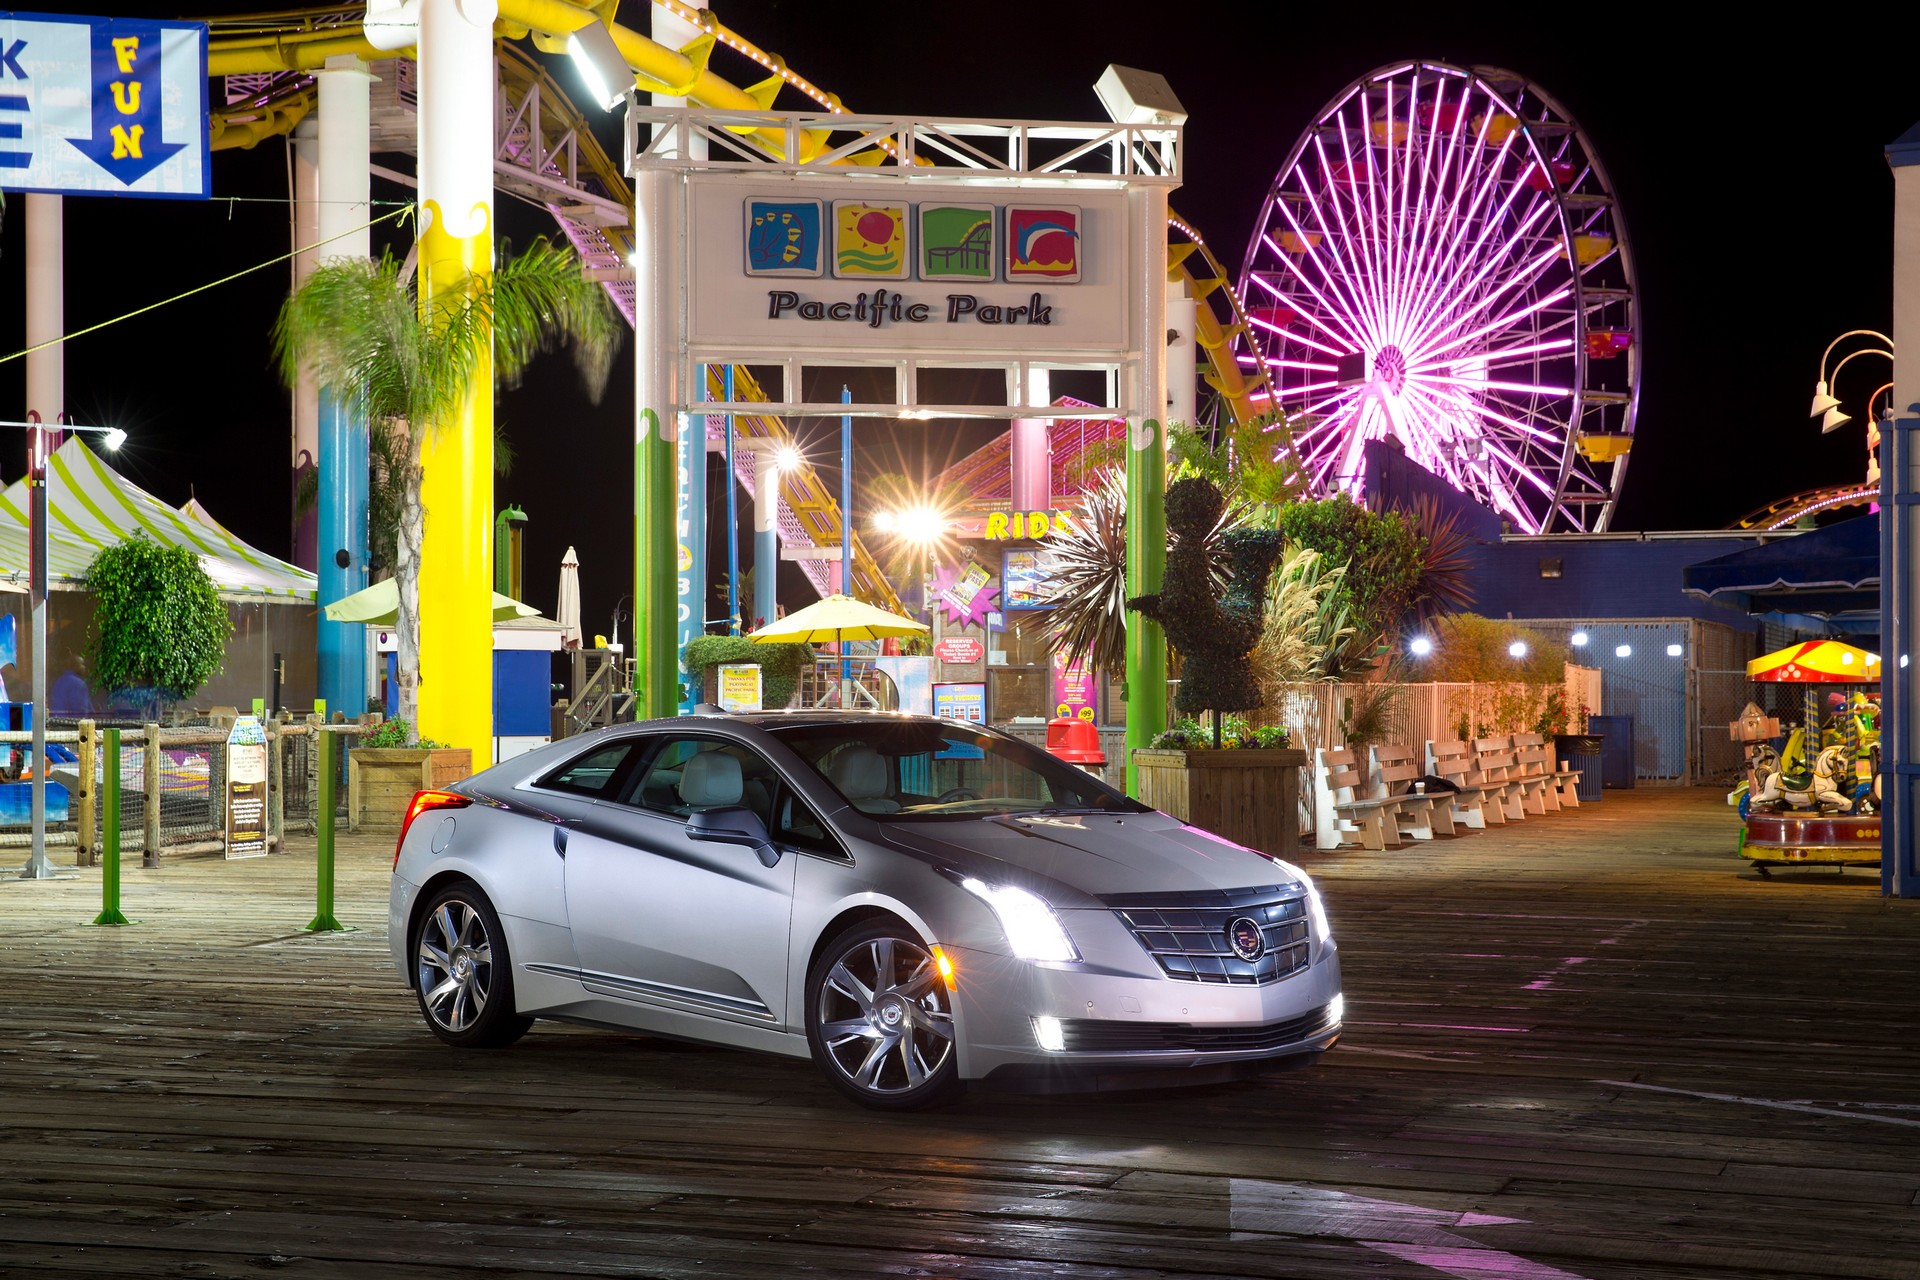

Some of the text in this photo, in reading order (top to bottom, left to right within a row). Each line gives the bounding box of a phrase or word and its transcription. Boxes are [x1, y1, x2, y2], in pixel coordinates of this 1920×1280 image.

[109, 36, 145, 161] FUN
[767, 288, 1052, 329] Pacific Park
[967, 574, 983, 587] PASS
